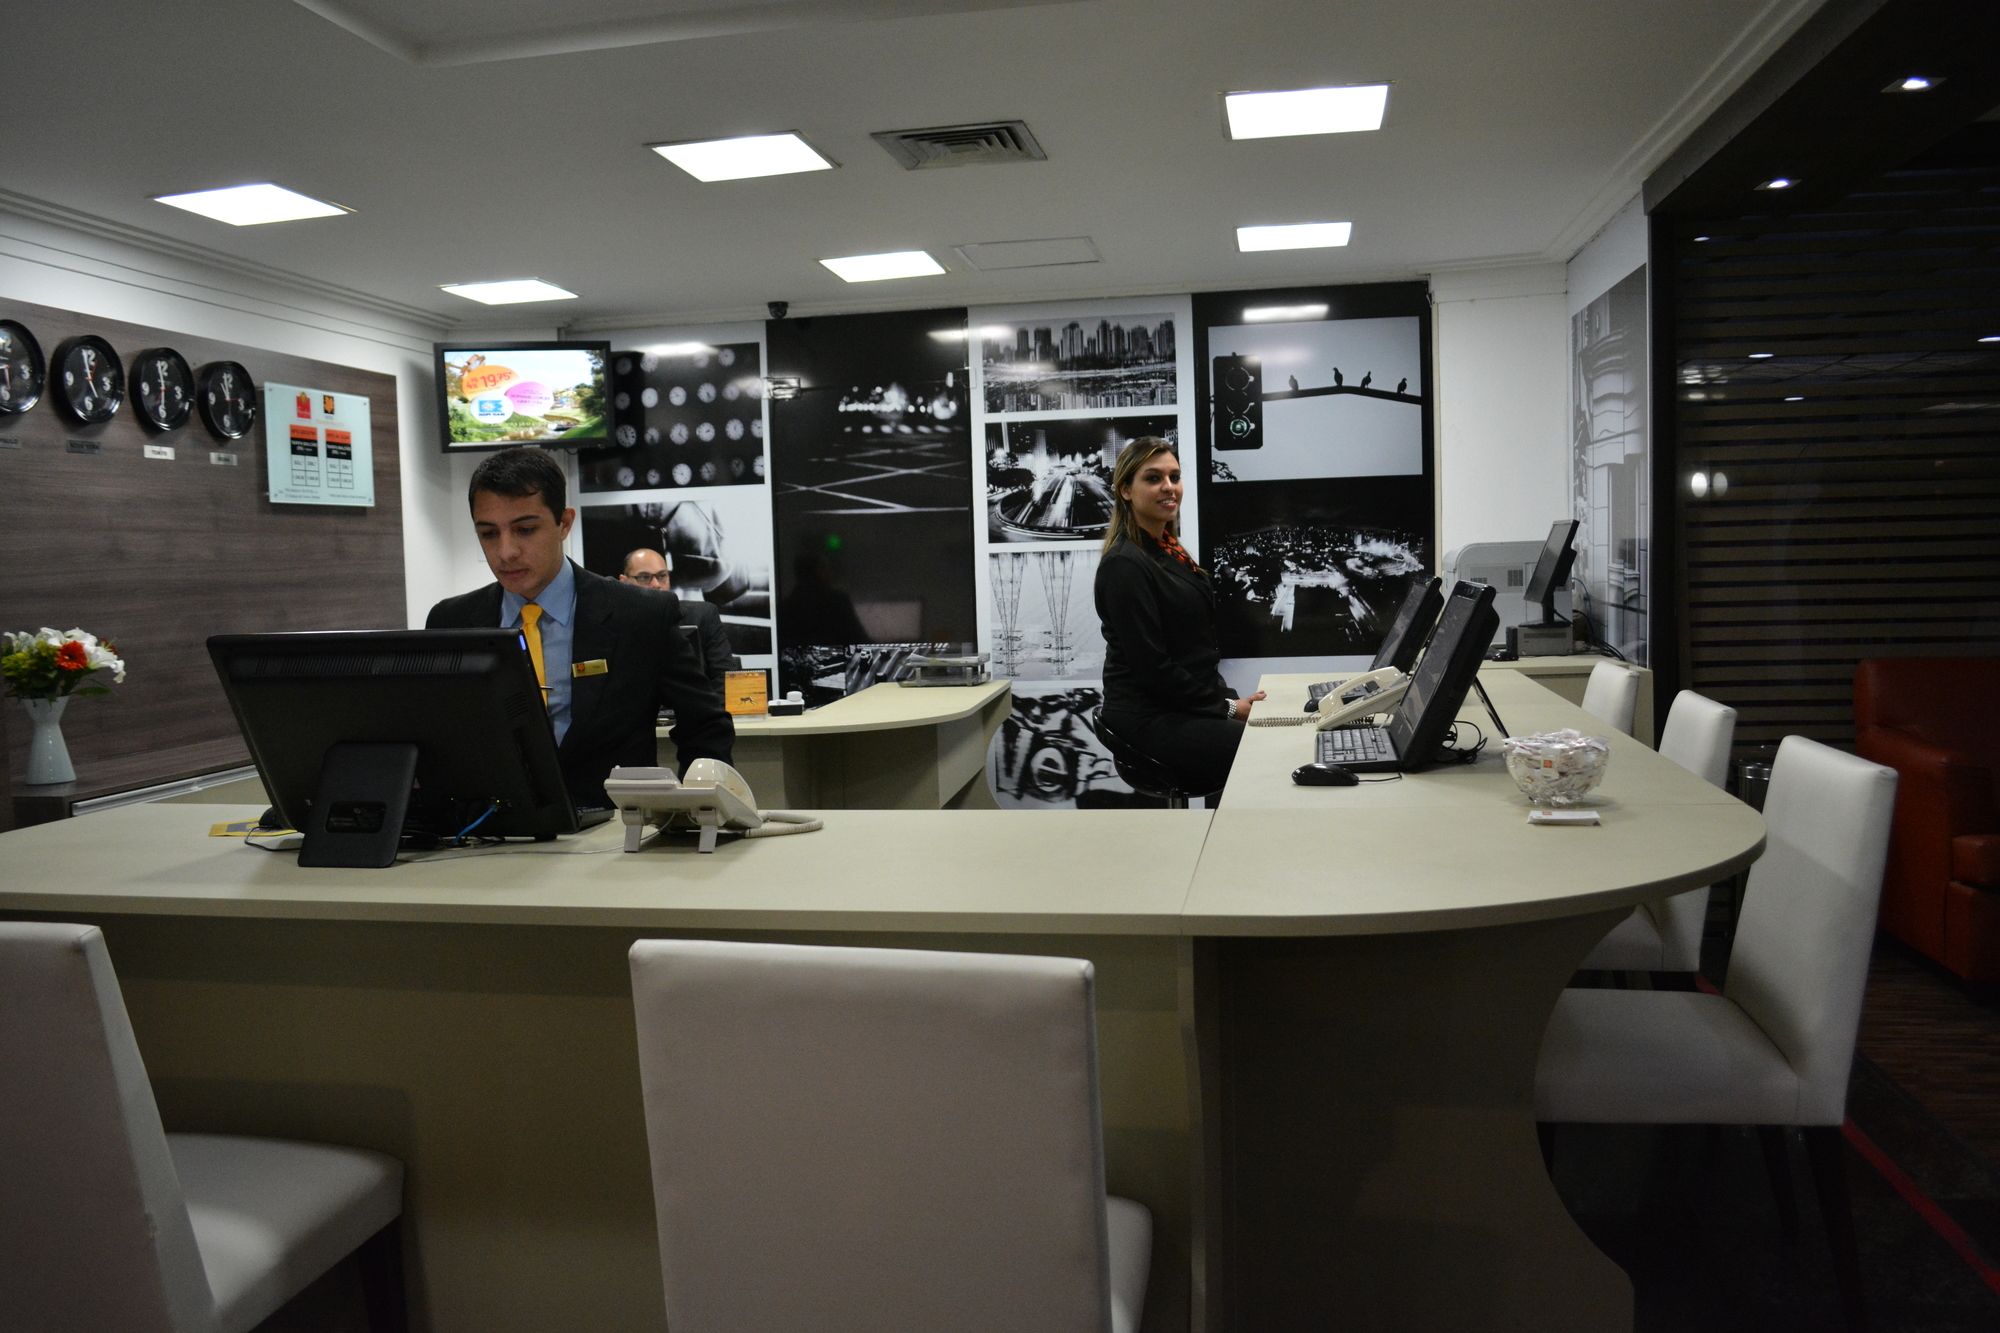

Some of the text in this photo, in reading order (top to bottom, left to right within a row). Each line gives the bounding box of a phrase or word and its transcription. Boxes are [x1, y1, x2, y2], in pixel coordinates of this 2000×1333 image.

[20, 364, 30, 380] 3
[65, 371, 74, 387] 9
[102, 376, 111, 392] 3
[141, 382, 150, 396] 9
[0, 385, 10, 401] 6
[174, 386, 183, 400] 3
[208, 392, 216, 405] 9
[84, 395, 93, 411] 6
[238, 398, 245, 411] 3
[158, 404, 167, 419] 6
[223, 415, 231, 428] 6
